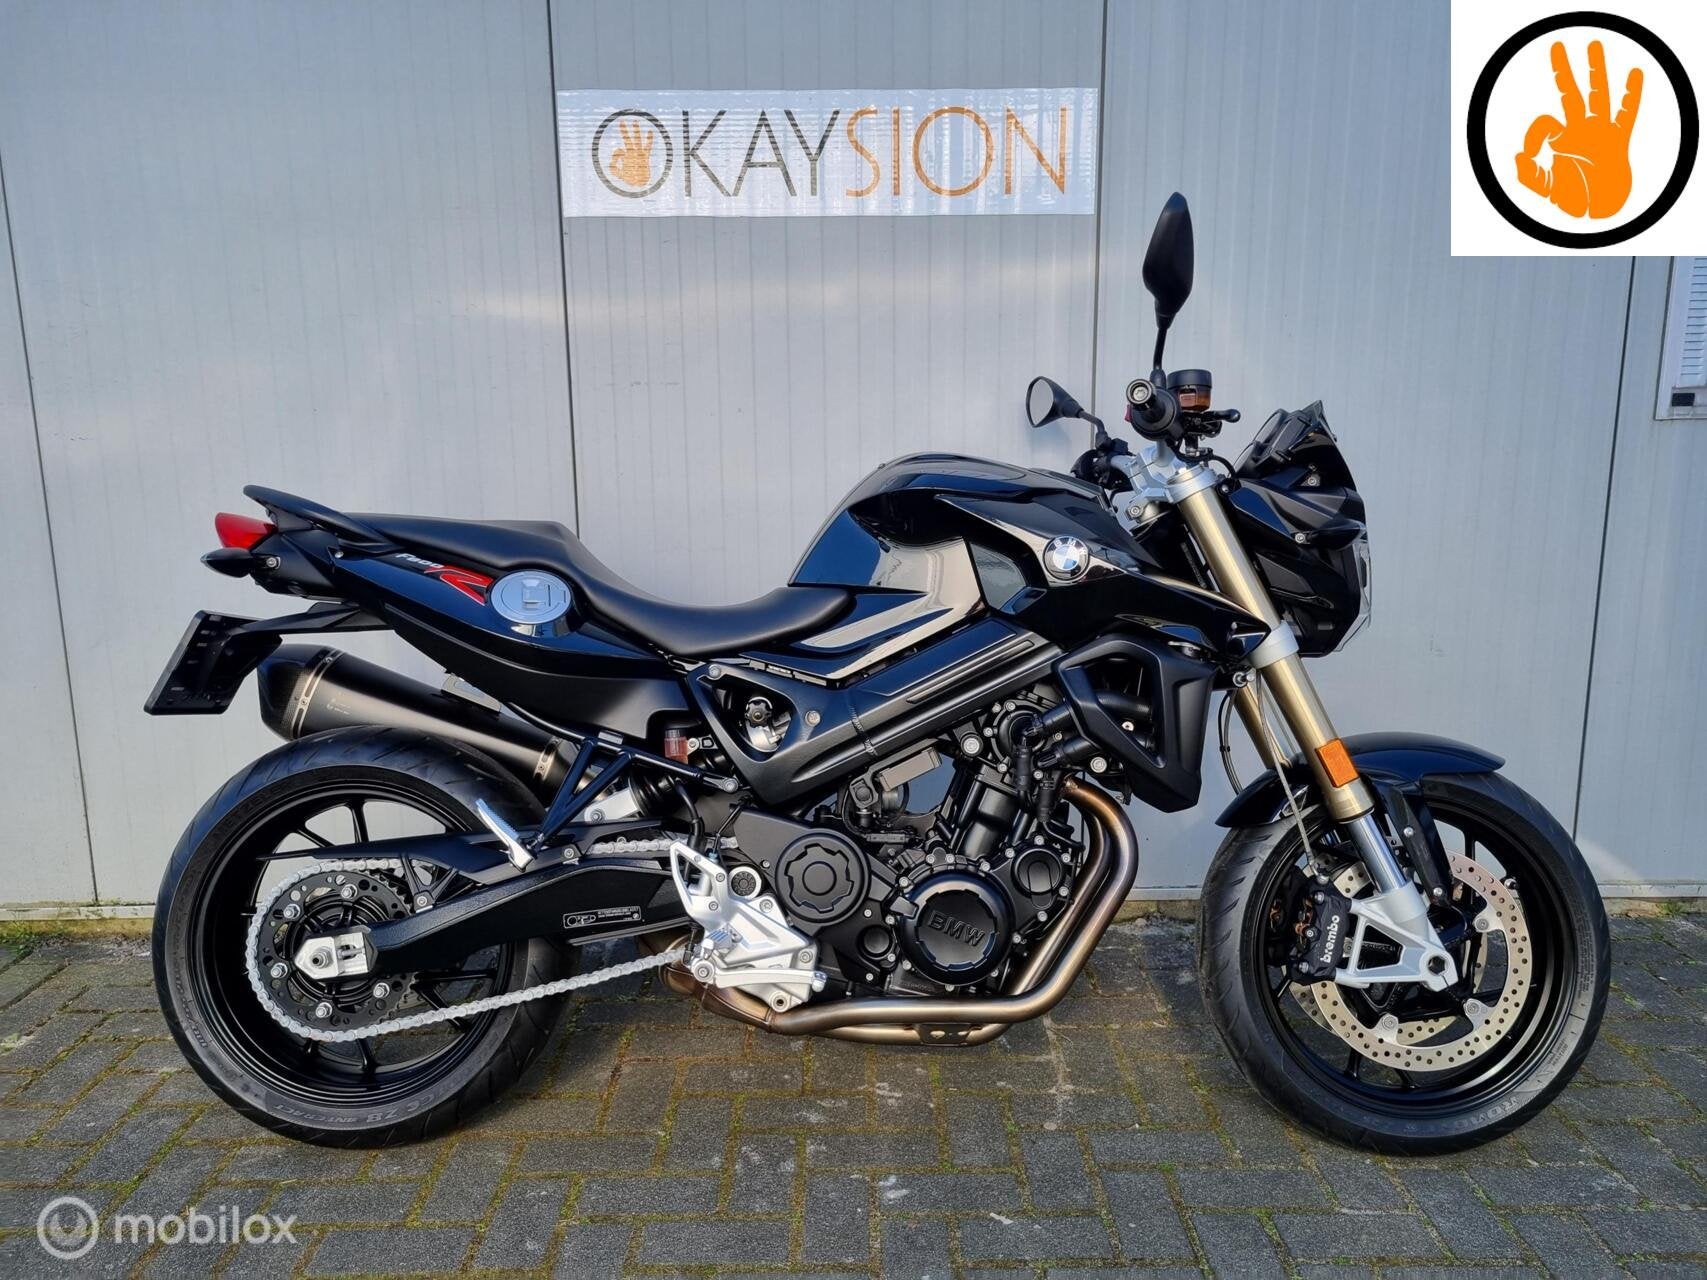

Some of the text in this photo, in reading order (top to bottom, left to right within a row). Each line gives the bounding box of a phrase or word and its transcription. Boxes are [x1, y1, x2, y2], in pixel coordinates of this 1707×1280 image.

[591, 105, 1067, 198] OKAYSION
[928, 909, 985, 947] BMW
[1320, 915, 1340, 963] brembo
